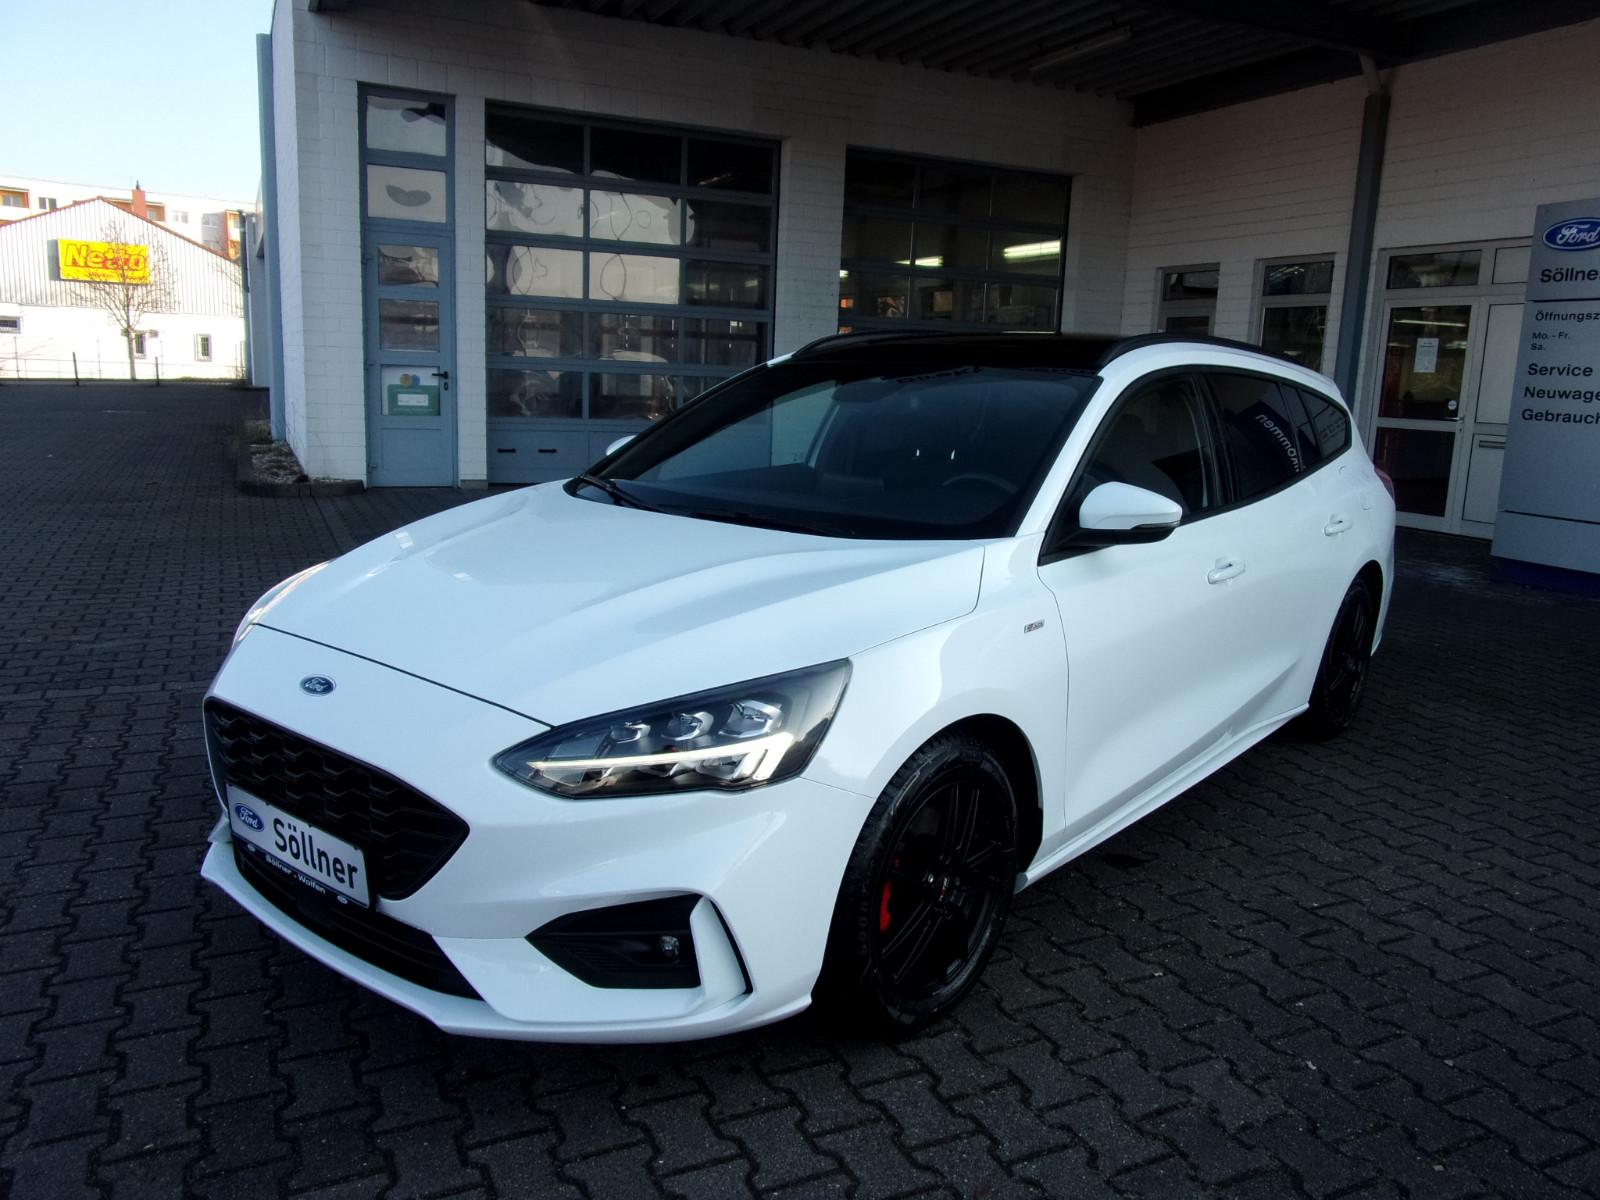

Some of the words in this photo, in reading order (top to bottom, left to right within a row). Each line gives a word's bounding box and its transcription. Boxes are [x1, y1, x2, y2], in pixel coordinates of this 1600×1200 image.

[1556, 223, 1599, 246] Ford
[65, 244, 145, 271] Netto
[1540, 267, 1600, 283] Söllne
[1535, 310, 1600, 323] Öffnungsz
[1528, 363, 1593, 377] Service
[273, 817, 358, 889] Söllner
